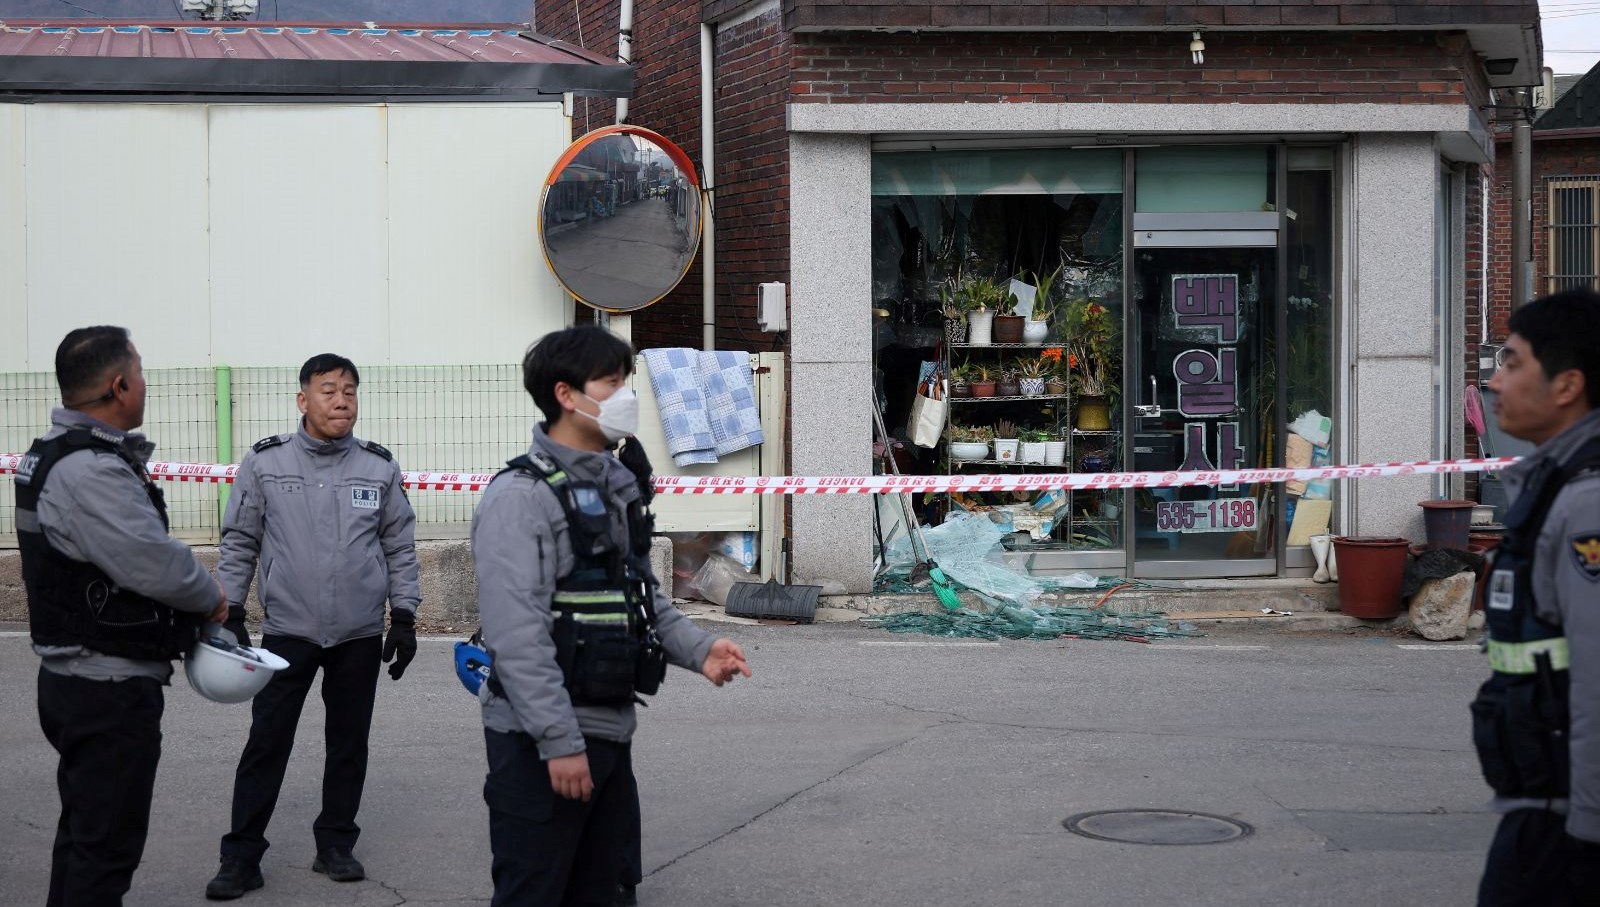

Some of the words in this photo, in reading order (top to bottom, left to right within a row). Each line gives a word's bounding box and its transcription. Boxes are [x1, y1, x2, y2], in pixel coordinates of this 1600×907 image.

[178, 465, 213, 475] DANGER
[698, 476, 745, 486] 안전제일
[783, 477, 805, 486] 위험
[818, 476, 866, 485] DANGER
[886, 476, 937, 486] 안전제일
[978, 476, 1002, 485] 위험
[1017, 475, 1070, 484] DANGER
[1238, 471, 1295, 482] DANGER
[354, 489, 376, 501] 경찰
[1157, 500, 1256, 530] 535-1138
